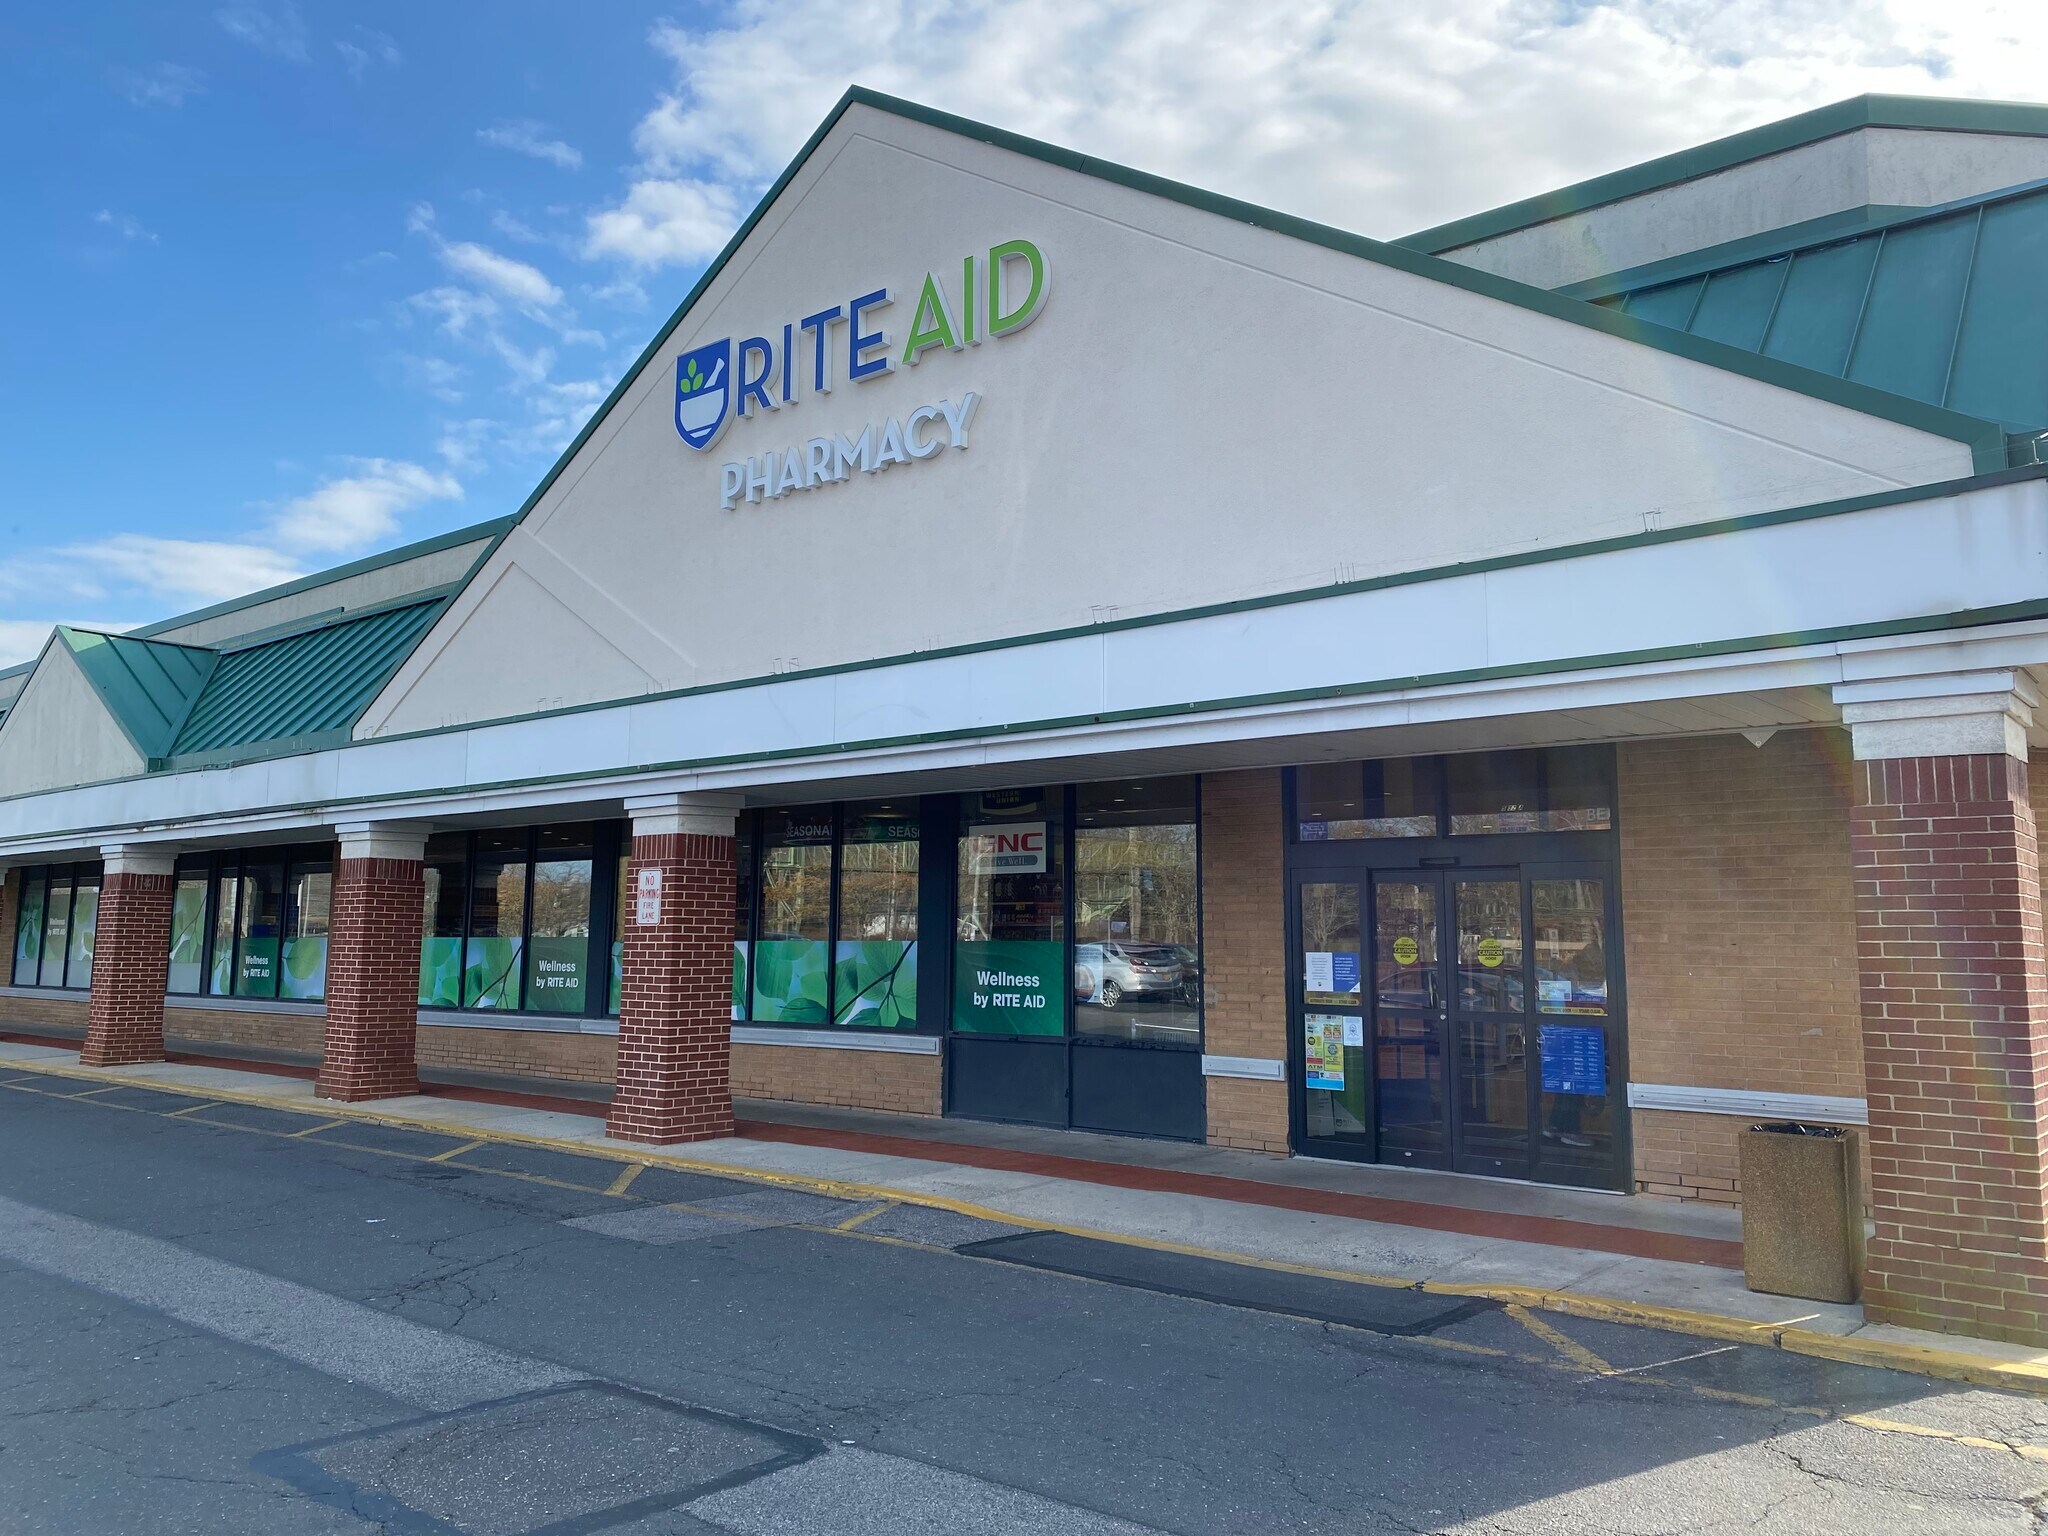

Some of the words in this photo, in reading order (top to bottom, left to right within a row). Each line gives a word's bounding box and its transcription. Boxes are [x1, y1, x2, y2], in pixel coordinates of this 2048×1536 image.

[737, 287, 895, 419] RITE
[902, 239, 1051, 366] AID
[720, 391, 982, 511] PHARMACY
[996, 796, 1020, 804] UNION
[888, 825, 920, 838] SEAS
[972, 832, 1043, 853] GNC
[645, 875, 655, 886] NO
[640, 888, 660, 899] PARKING
[643, 901, 654, 910] FIRE
[642, 911, 655, 920] LANE
[245, 955, 269, 965] Wellness
[538, 960, 576, 972] Wellness
[242, 968, 249, 979] by
[250, 968, 261, 977] RITE
[261, 969, 270, 978] AID
[976, 970, 1041, 988] Wellness
[535, 976, 546, 989] by
[547, 977, 564, 988] RITE
[565, 977, 579, 988] AID
[973, 991, 989, 1009] by
[992, 993, 1021, 1008] RITE
[1023, 994, 1046, 1009] AID
